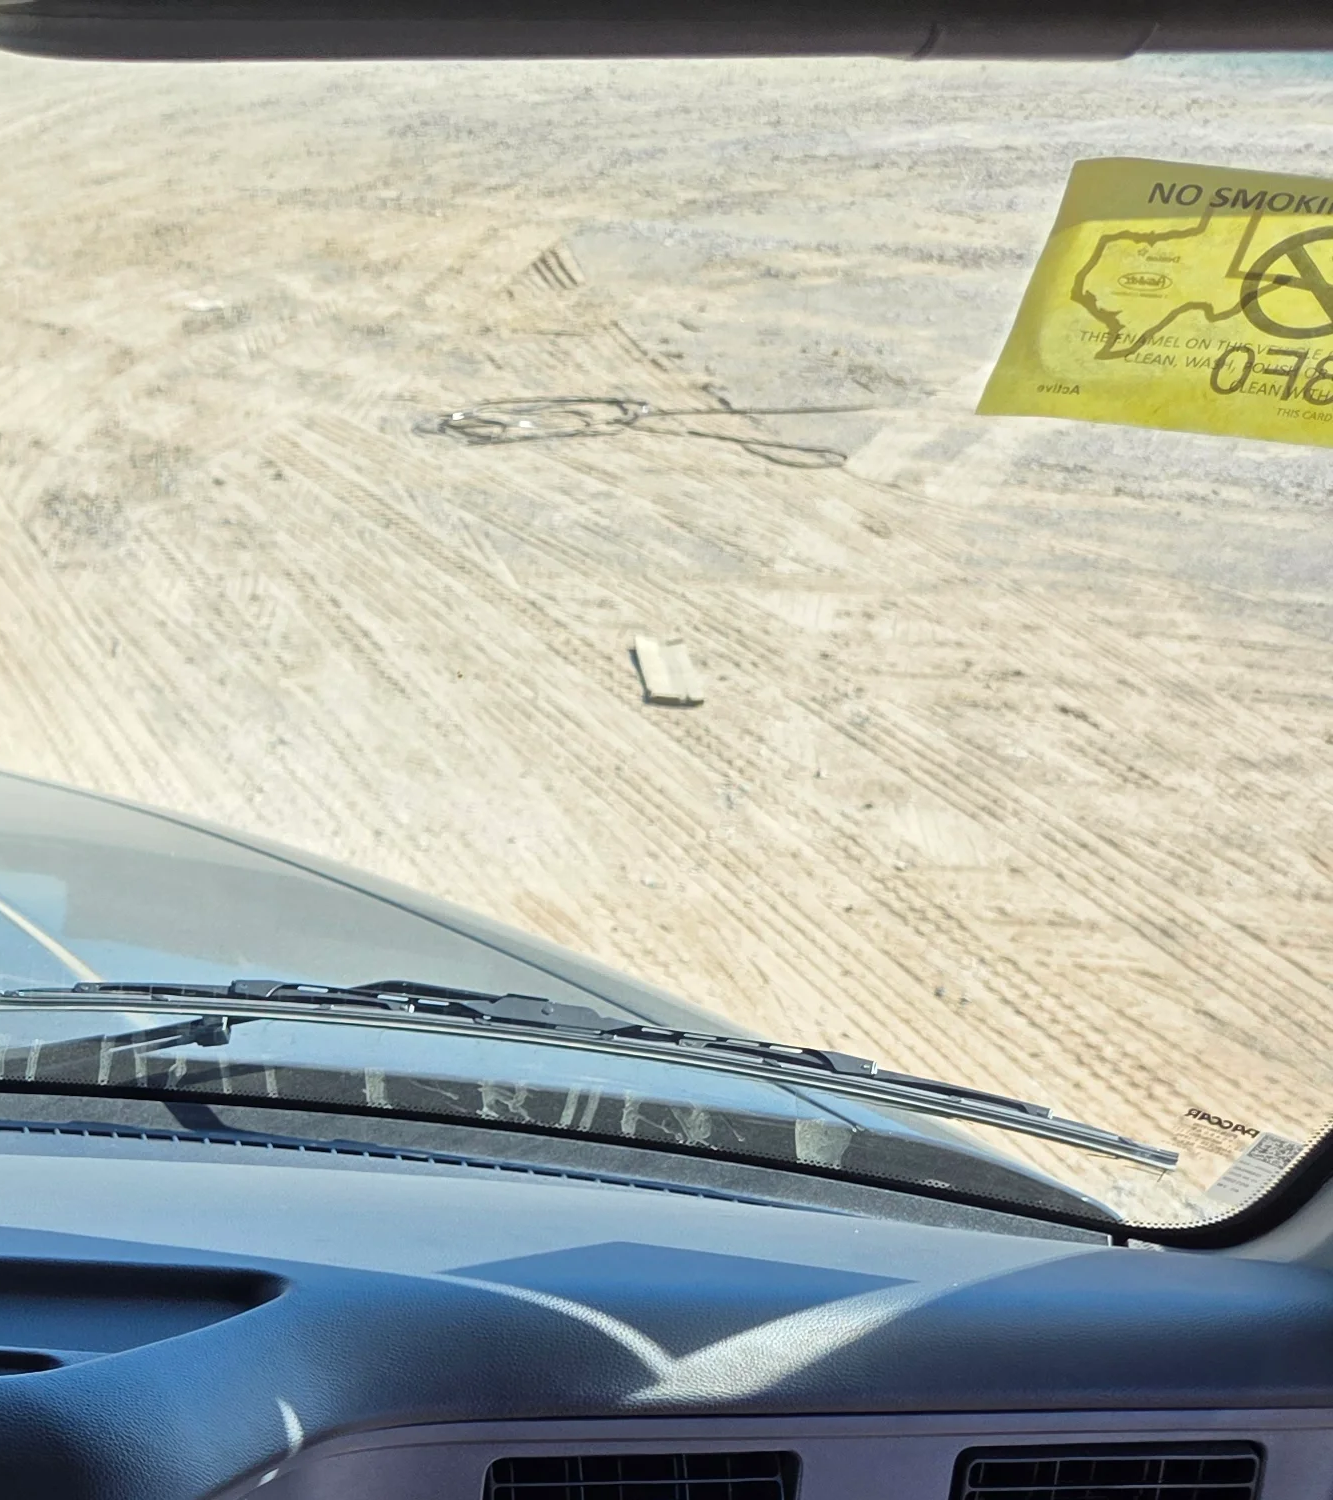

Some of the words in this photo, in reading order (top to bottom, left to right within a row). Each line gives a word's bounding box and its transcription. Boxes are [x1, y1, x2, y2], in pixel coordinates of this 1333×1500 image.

[1148, 182, 1203, 206] NO
[1209, 187, 1333, 215] SMOKI
[1080, 331, 1110, 343] THE
[1185, 338, 1211, 350] ON
[1214, 340, 1254, 354] THIS
[1124, 352, 1177, 368] CLEAN,
[1230, 380, 1282, 397] CLEAN
[1277, 408, 1300, 418] THIS
